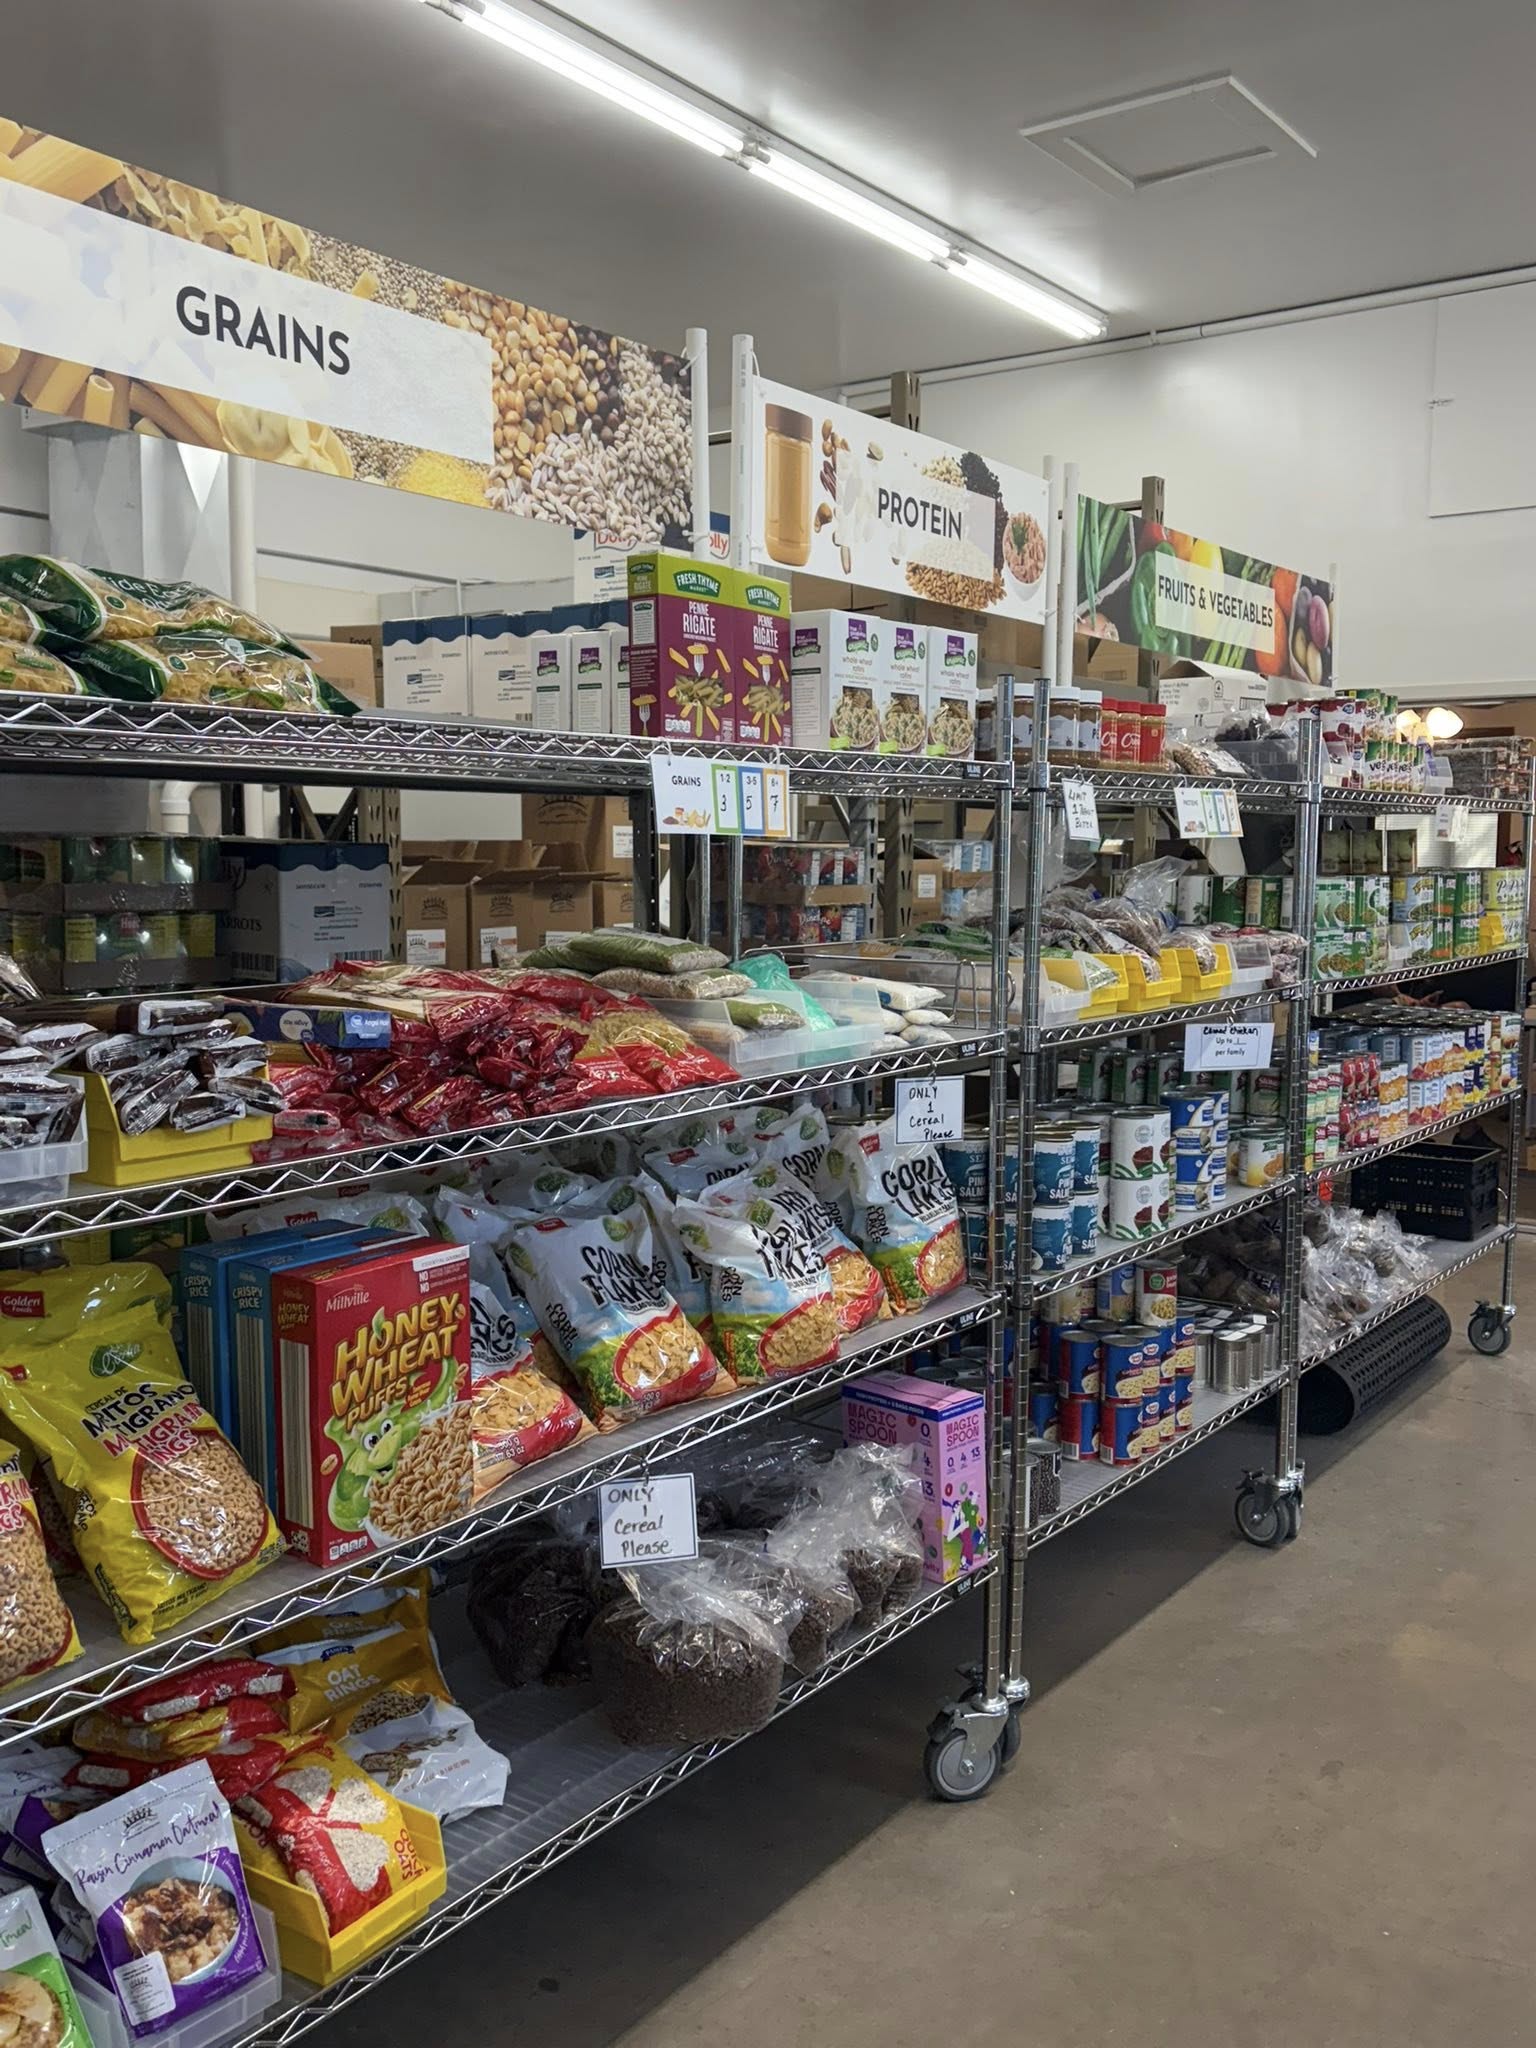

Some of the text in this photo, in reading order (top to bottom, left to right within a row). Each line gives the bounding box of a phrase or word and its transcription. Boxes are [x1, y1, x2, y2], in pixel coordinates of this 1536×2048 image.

[176, 286, 351, 376] GRAINS
[877, 487, 962, 541] PROTEIN
[676, 572, 719, 595] FRESH THYME
[748, 587, 781, 608] FRESH THYME
[1158, 575, 1274, 628] FRUITS & VEGETABLES
[689, 601, 710, 616] PENNE
[683, 613, 716, 637] RIGATE
[758, 614, 773, 629] PENNE
[753, 626, 779, 648] RIGATE
[671, 775, 701, 787] GRAINS
[720, 794, 779, 812] 3 5 7
[1216, 1037, 1225, 1046] Up
[1227, 1048, 1245, 1057] family
[908, 1086, 938, 1100] ONLY
[927, 1101, 935, 1114] 1
[909, 1113, 944, 1128] Cereal
[923, 1128, 955, 1142] Please
[183, 1275, 212, 1288] CRISPY
[2, 1295, 41, 1307] Golden
[189, 1286, 209, 1298] RICE
[232, 1286, 263, 1299] CRISPY
[238, 1298, 260, 1310] RICE
[278, 1303, 310, 1315] HONEY
[325, 1291, 370, 1313] Millville
[277, 1313, 310, 1325] WHEAT
[334, 1291, 461, 1381] HONEY
[331, 1324, 459, 1418] WHEAT
[345, 1375, 409, 1432] PUFFS
[847, 1402, 897, 1430] MAGIC
[946, 1414, 980, 1436] MAGIC
[848, 1418, 898, 1445] SPOON
[946, 1426, 980, 1447] SPOON
[608, 1486, 655, 1504] ONLY
[642, 1504, 648, 1517] 1
[614, 1515, 664, 1536] Cereal
[621, 1539, 673, 1558] Please
[327, 1664, 362, 1686] OAT
[324, 1674, 381, 1702] RINGS
[73, 1800, 221, 1893] Raisin Cinnamon Oatmeal
